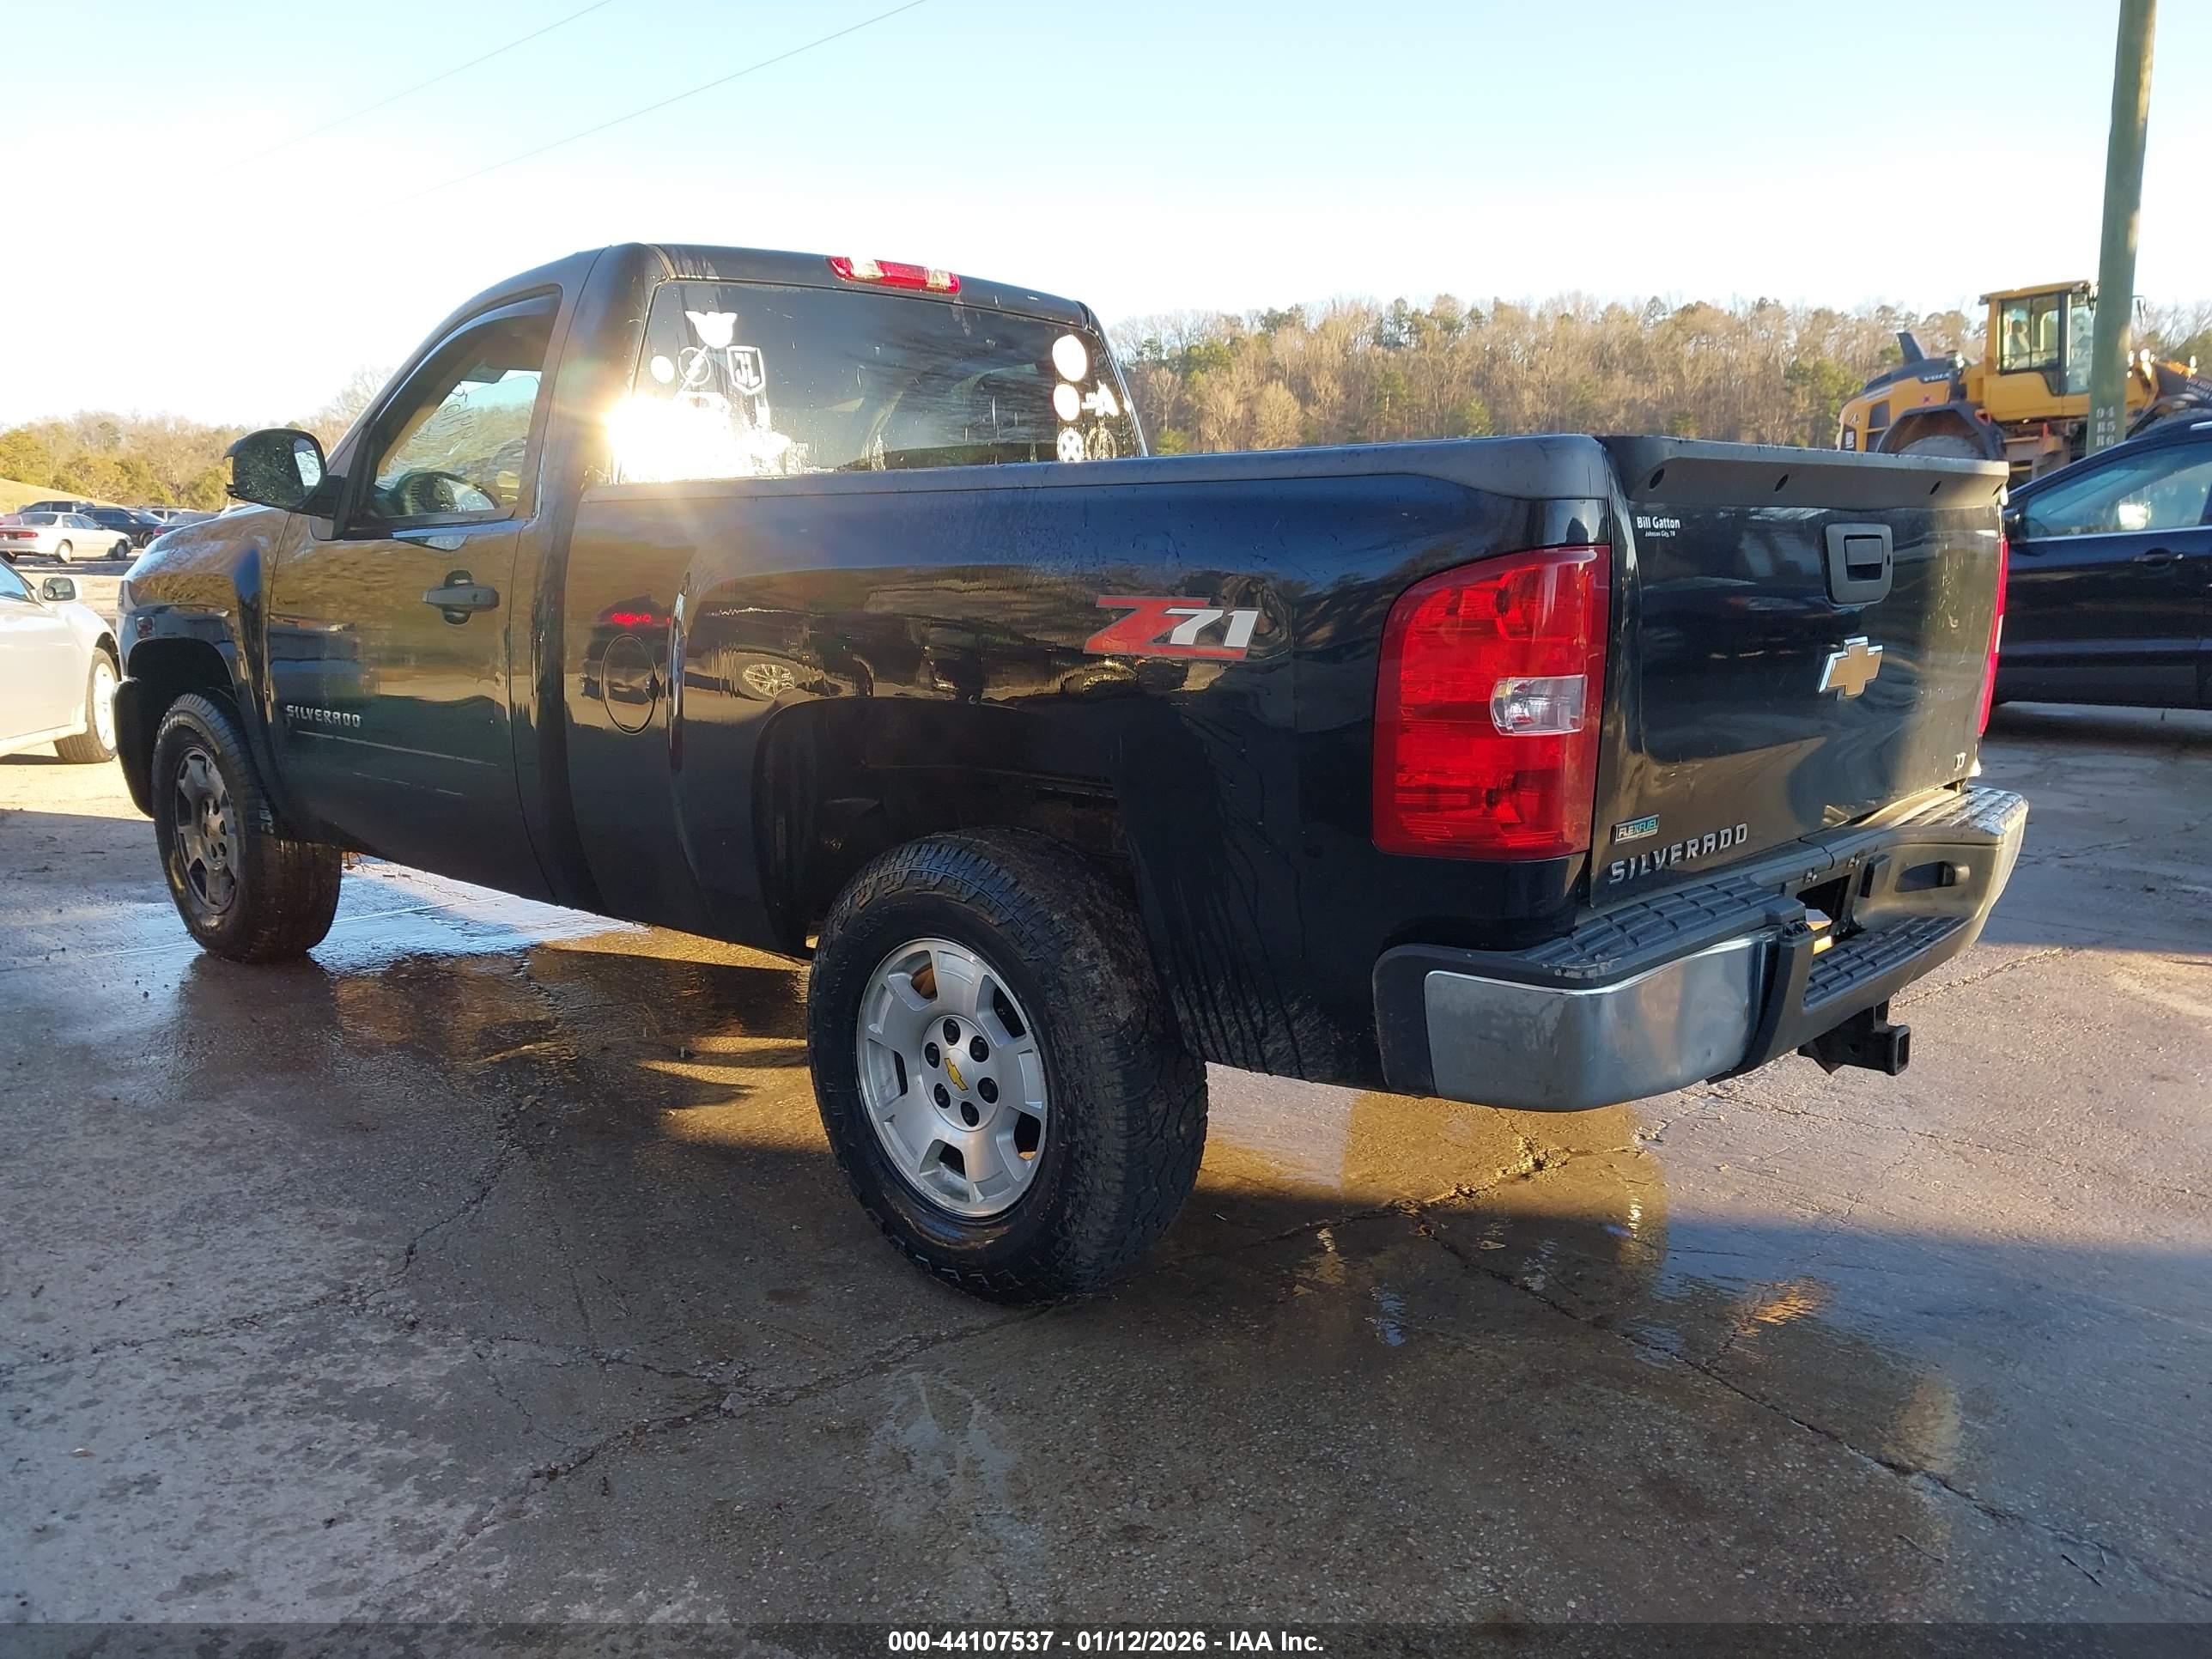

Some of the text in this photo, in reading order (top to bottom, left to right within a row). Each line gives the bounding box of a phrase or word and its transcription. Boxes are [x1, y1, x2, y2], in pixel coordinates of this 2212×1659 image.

[1636, 516, 1680, 529] Bill Gatton
[1083, 595, 1262, 661] Z71
[286, 704, 362, 728] SILVERADO
[1618, 817, 1657, 839] FLEXFUEL
[1608, 822, 1749, 885] SILVERADO
